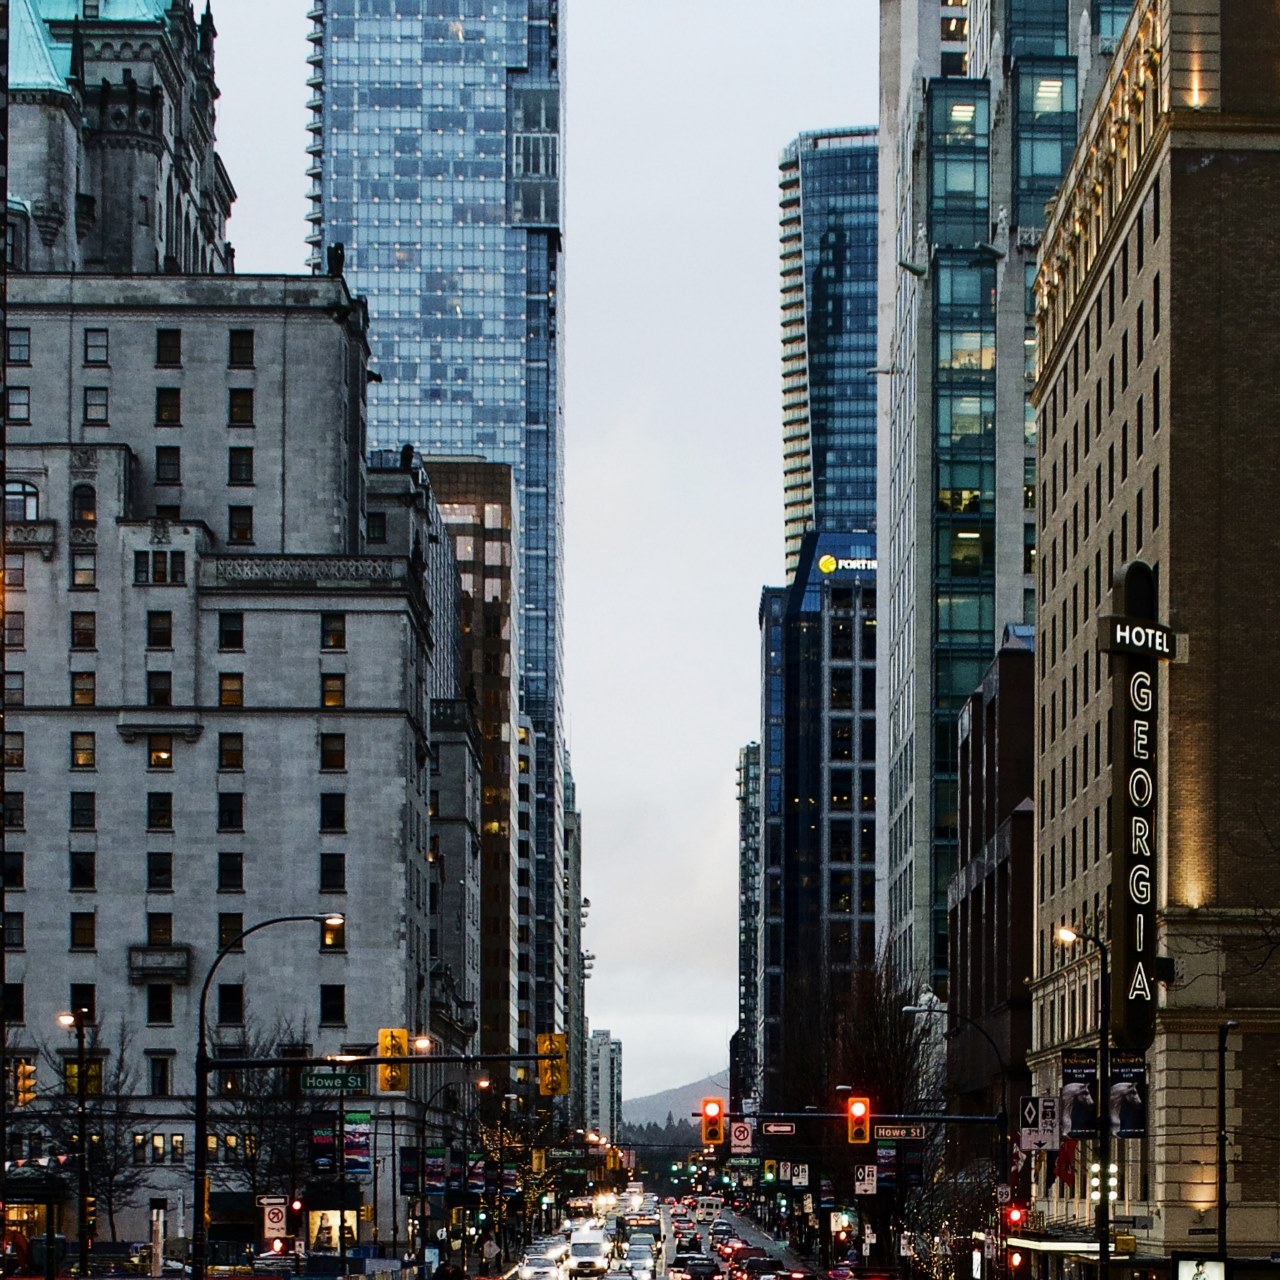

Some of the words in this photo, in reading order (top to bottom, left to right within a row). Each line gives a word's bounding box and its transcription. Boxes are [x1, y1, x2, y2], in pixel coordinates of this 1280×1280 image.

[1116, 624, 1170, 654] HOTEL
[1128, 671, 1153, 1001] GEORGIA
[306, 1077, 342, 1087] Howe
[347, 1076, 362, 1087] St
[878, 1128, 907, 1137] Howe
[910, 1128, 921, 1137] St
[998, 1190, 1010, 1199] 99
